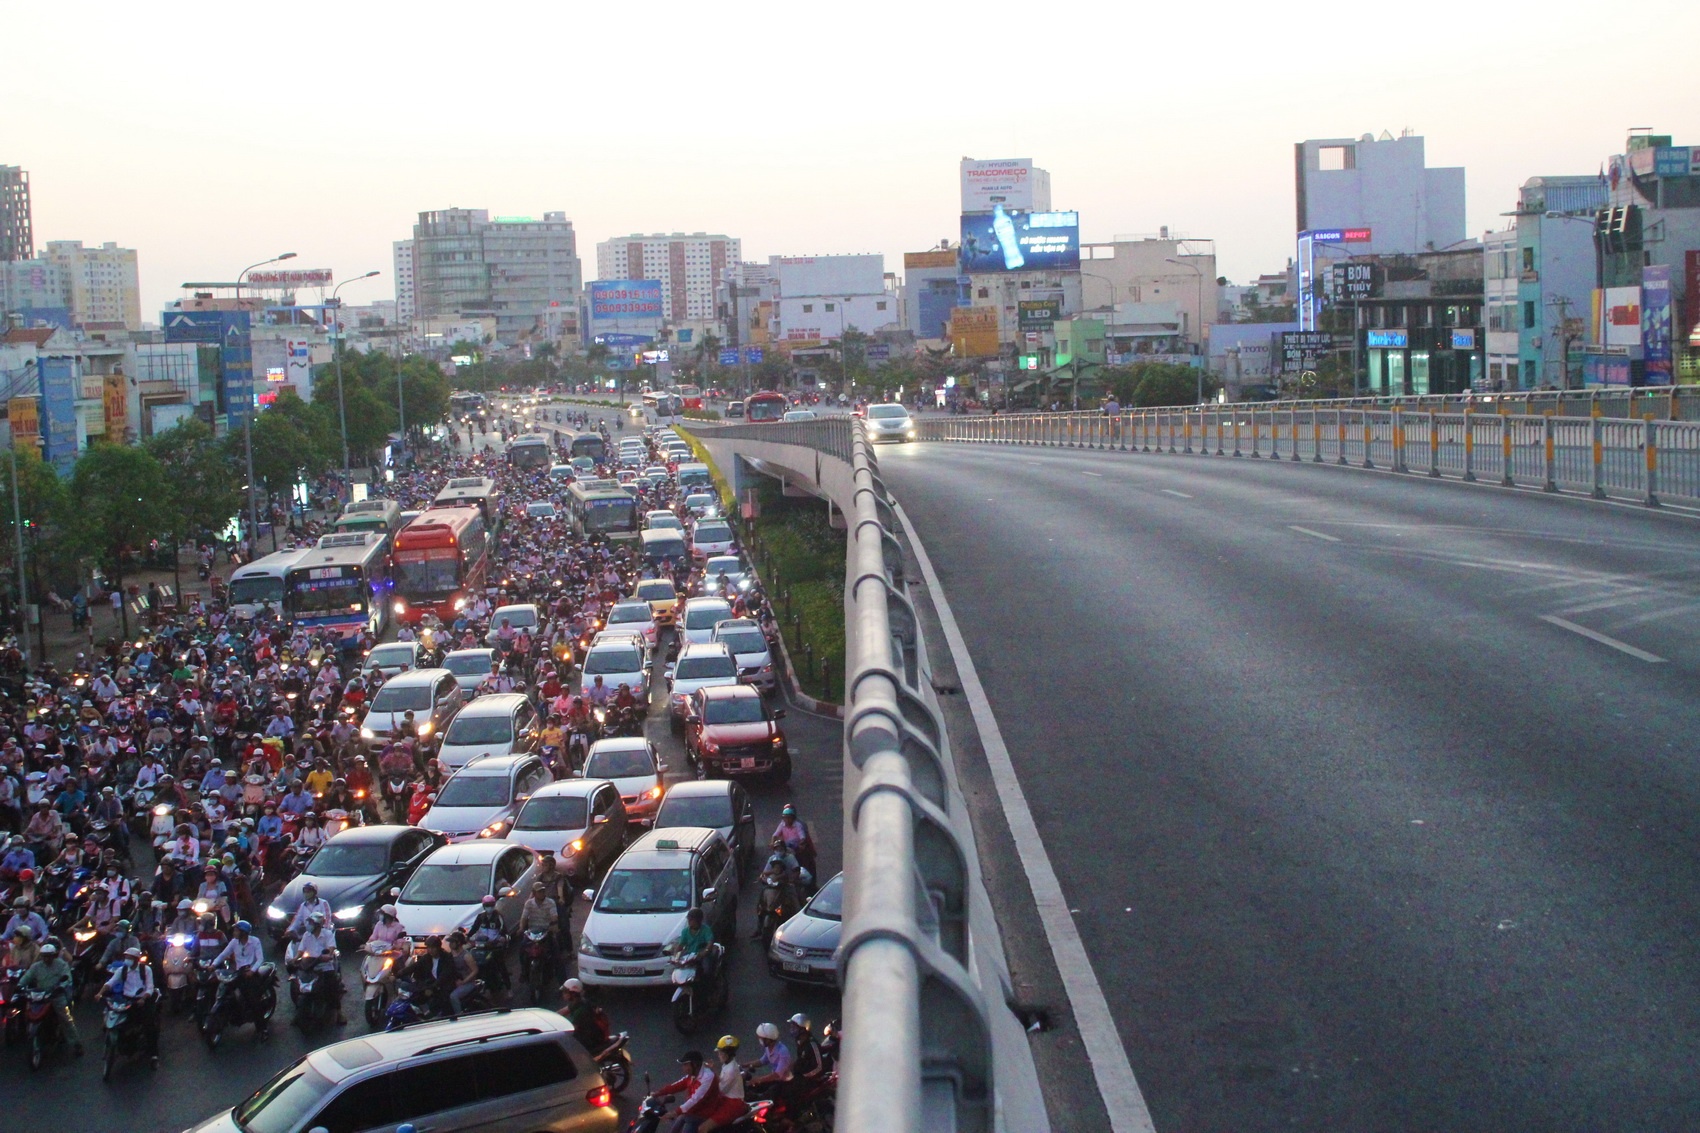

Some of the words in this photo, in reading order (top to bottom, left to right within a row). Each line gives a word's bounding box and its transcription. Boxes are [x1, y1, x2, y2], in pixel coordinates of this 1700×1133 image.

[967, 168, 1028, 178] TRACOMECO
[1314, 232, 1340, 240] SAIGON
[1027, 309, 1050, 319] LED
